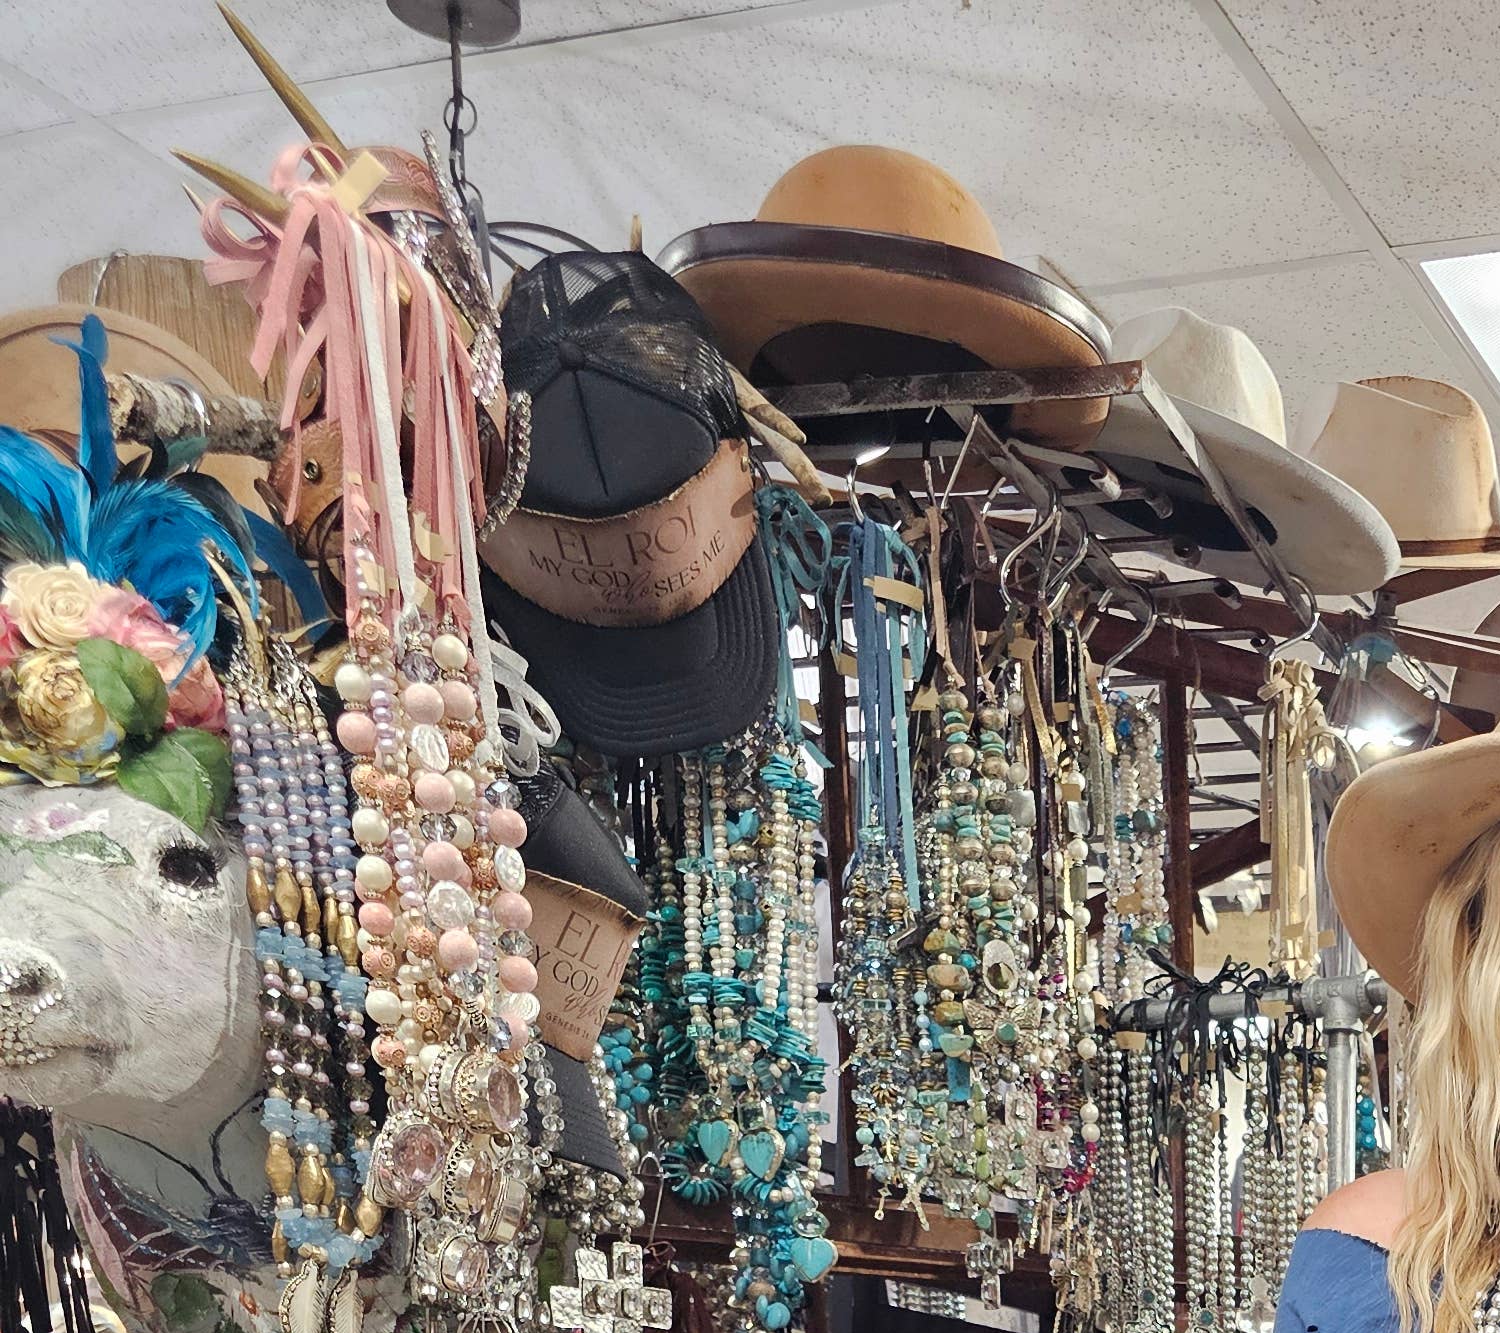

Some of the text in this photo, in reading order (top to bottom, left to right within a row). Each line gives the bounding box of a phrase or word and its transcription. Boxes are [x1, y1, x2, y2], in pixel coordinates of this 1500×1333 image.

[528, 549, 562, 577] MY
[571, 567, 631, 588] GOD
[653, 560, 701, 598] SEES
[702, 530, 726, 569] ME
[553, 506, 696, 567] EL ROI
[554, 909, 600, 970] EL
[527, 944, 551, 967] Y
[552, 959, 599, 998] GOD
